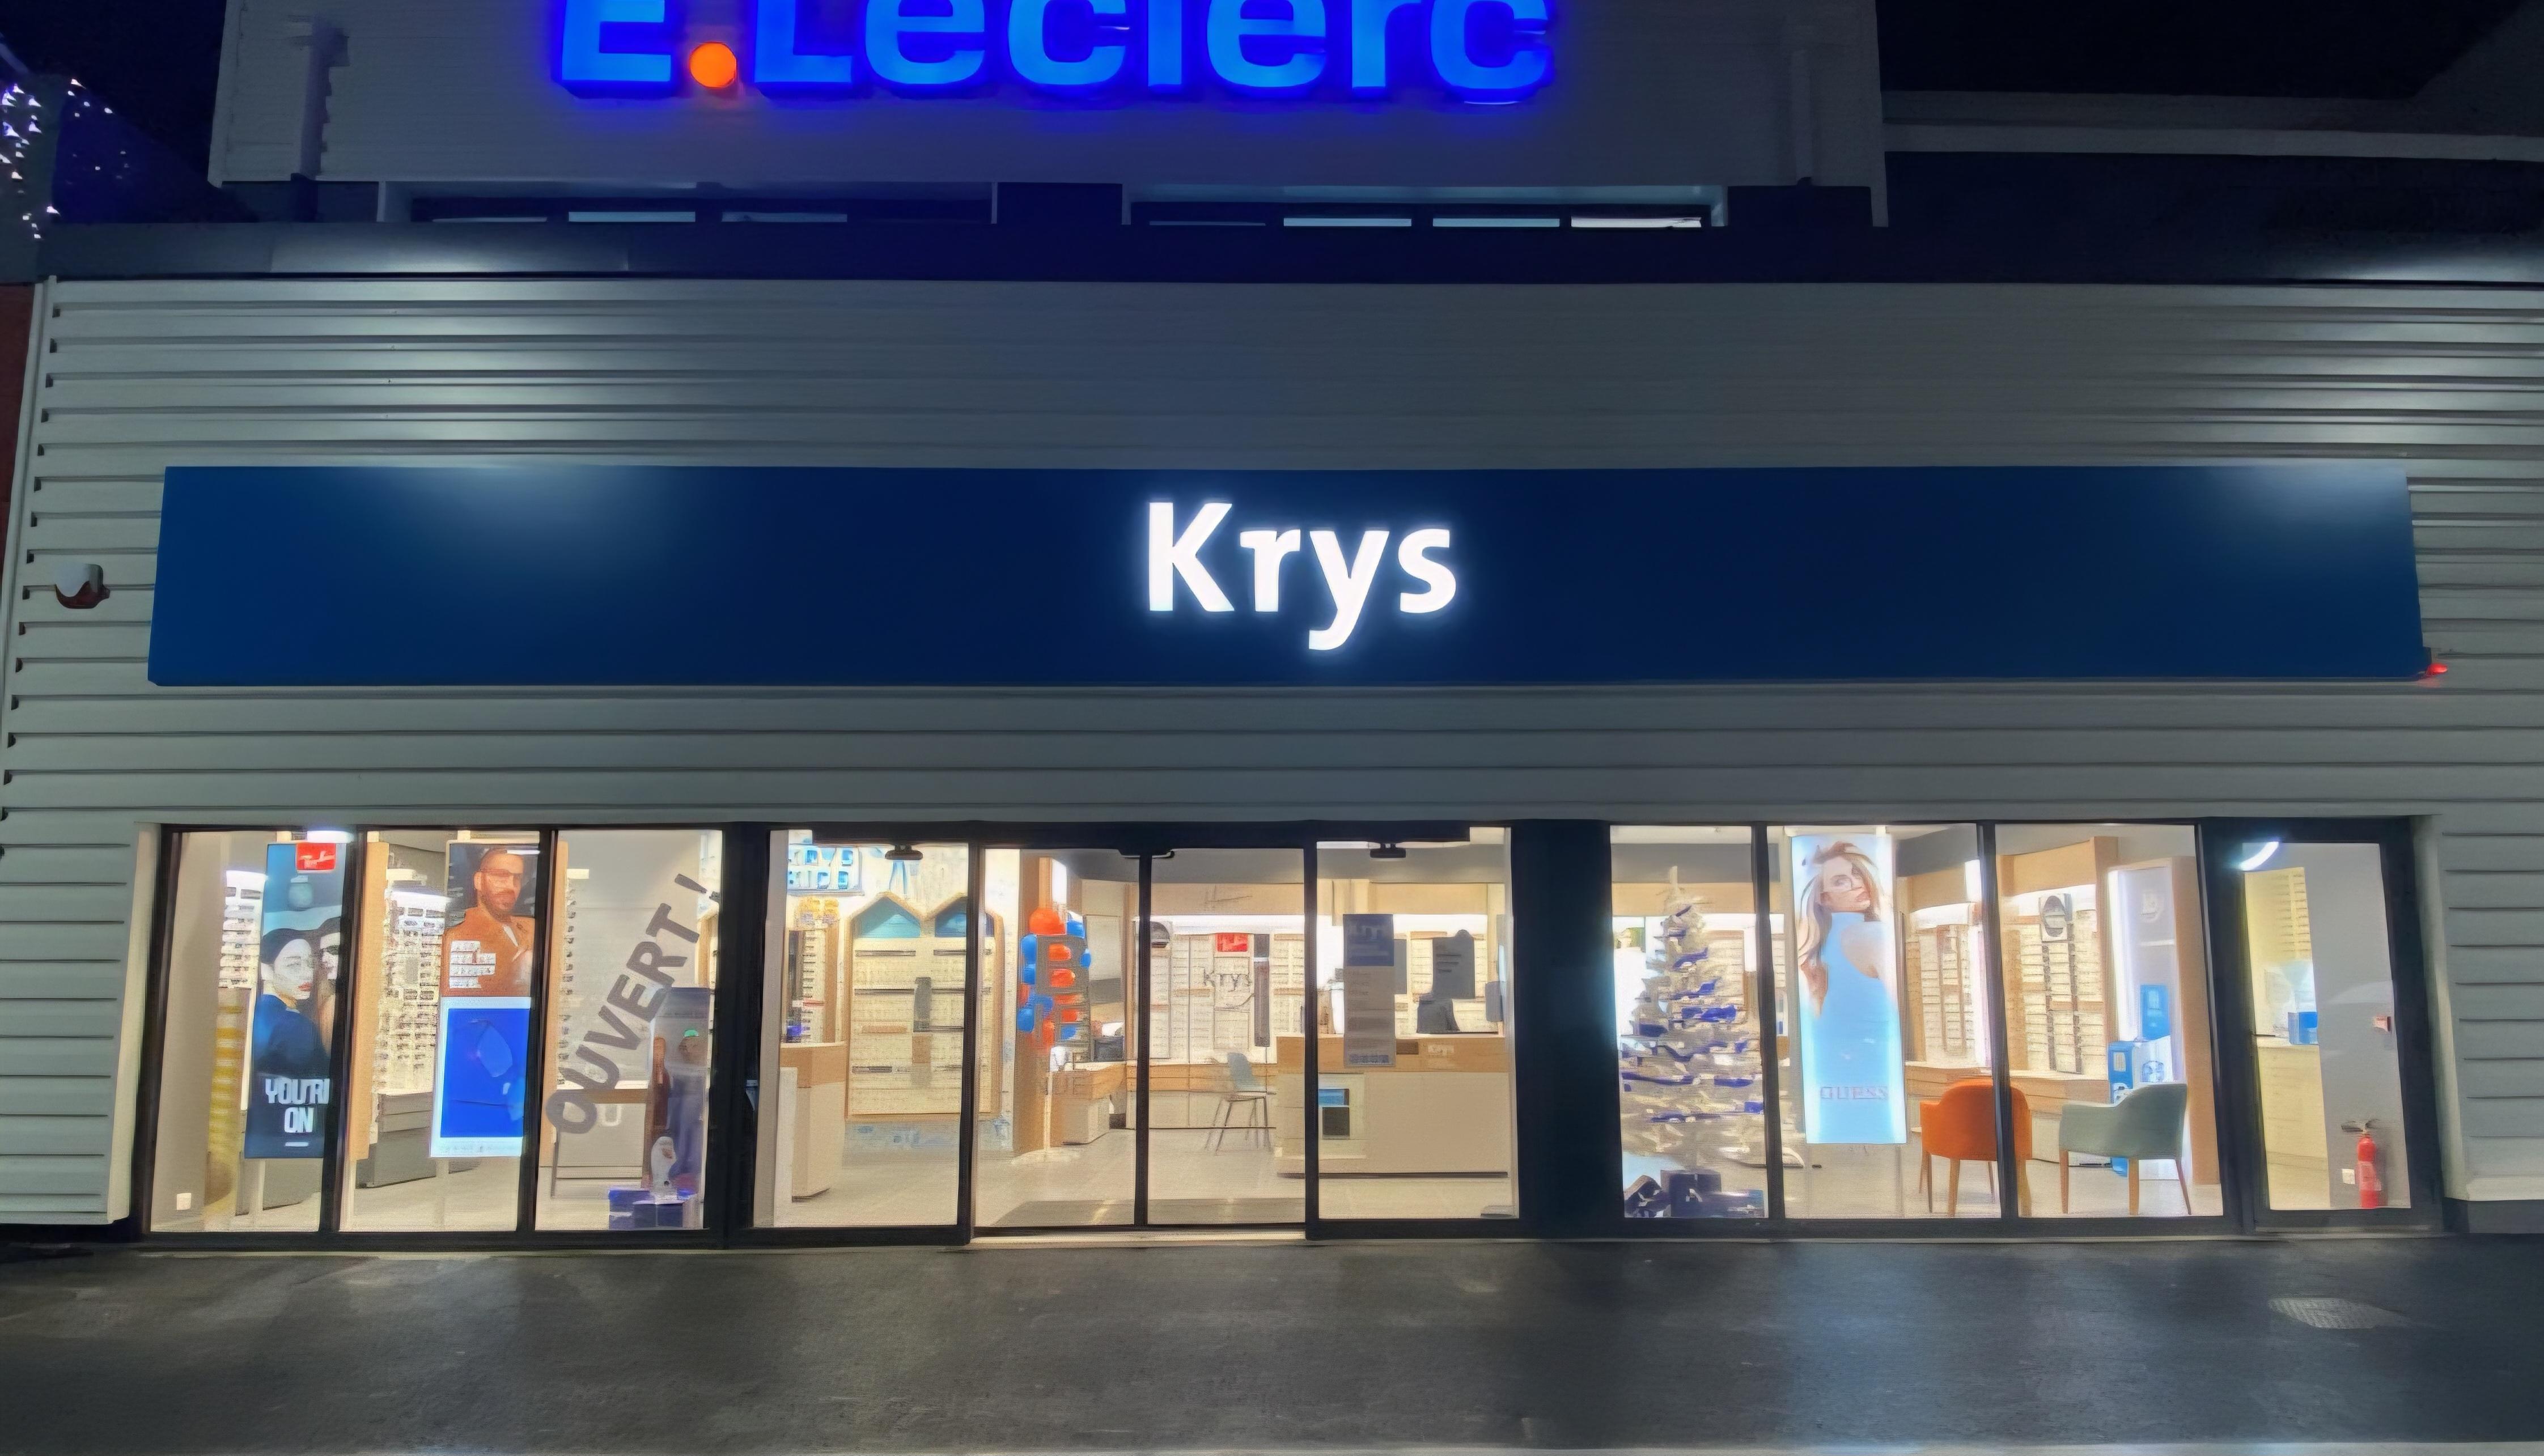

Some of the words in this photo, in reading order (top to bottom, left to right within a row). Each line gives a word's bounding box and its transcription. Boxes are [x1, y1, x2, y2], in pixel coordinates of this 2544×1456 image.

[1148, 502, 1457, 651] Krys
[546, 902, 700, 1134] OUVERT
[284, 1106, 314, 1133] ON
